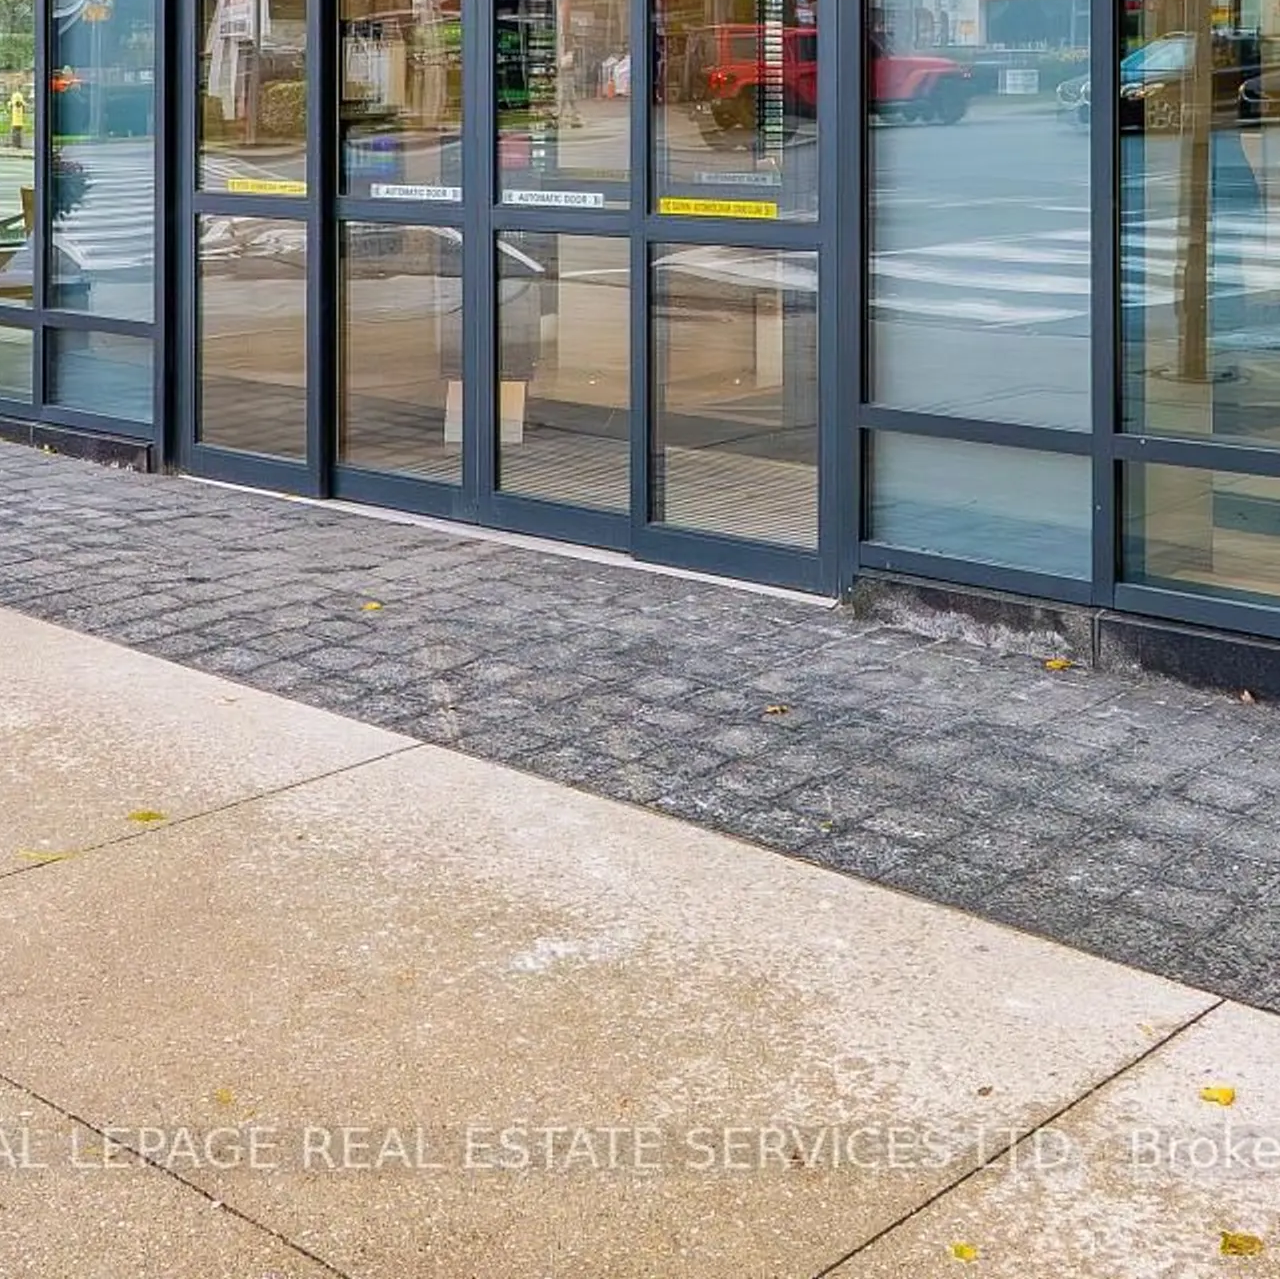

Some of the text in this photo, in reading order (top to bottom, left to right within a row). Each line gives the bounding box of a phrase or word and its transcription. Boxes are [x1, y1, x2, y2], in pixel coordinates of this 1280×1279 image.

[385, 186, 448, 199] AUTOMATIC DOOR
[518, 192, 588, 206] AUTOMATIC DOOR
